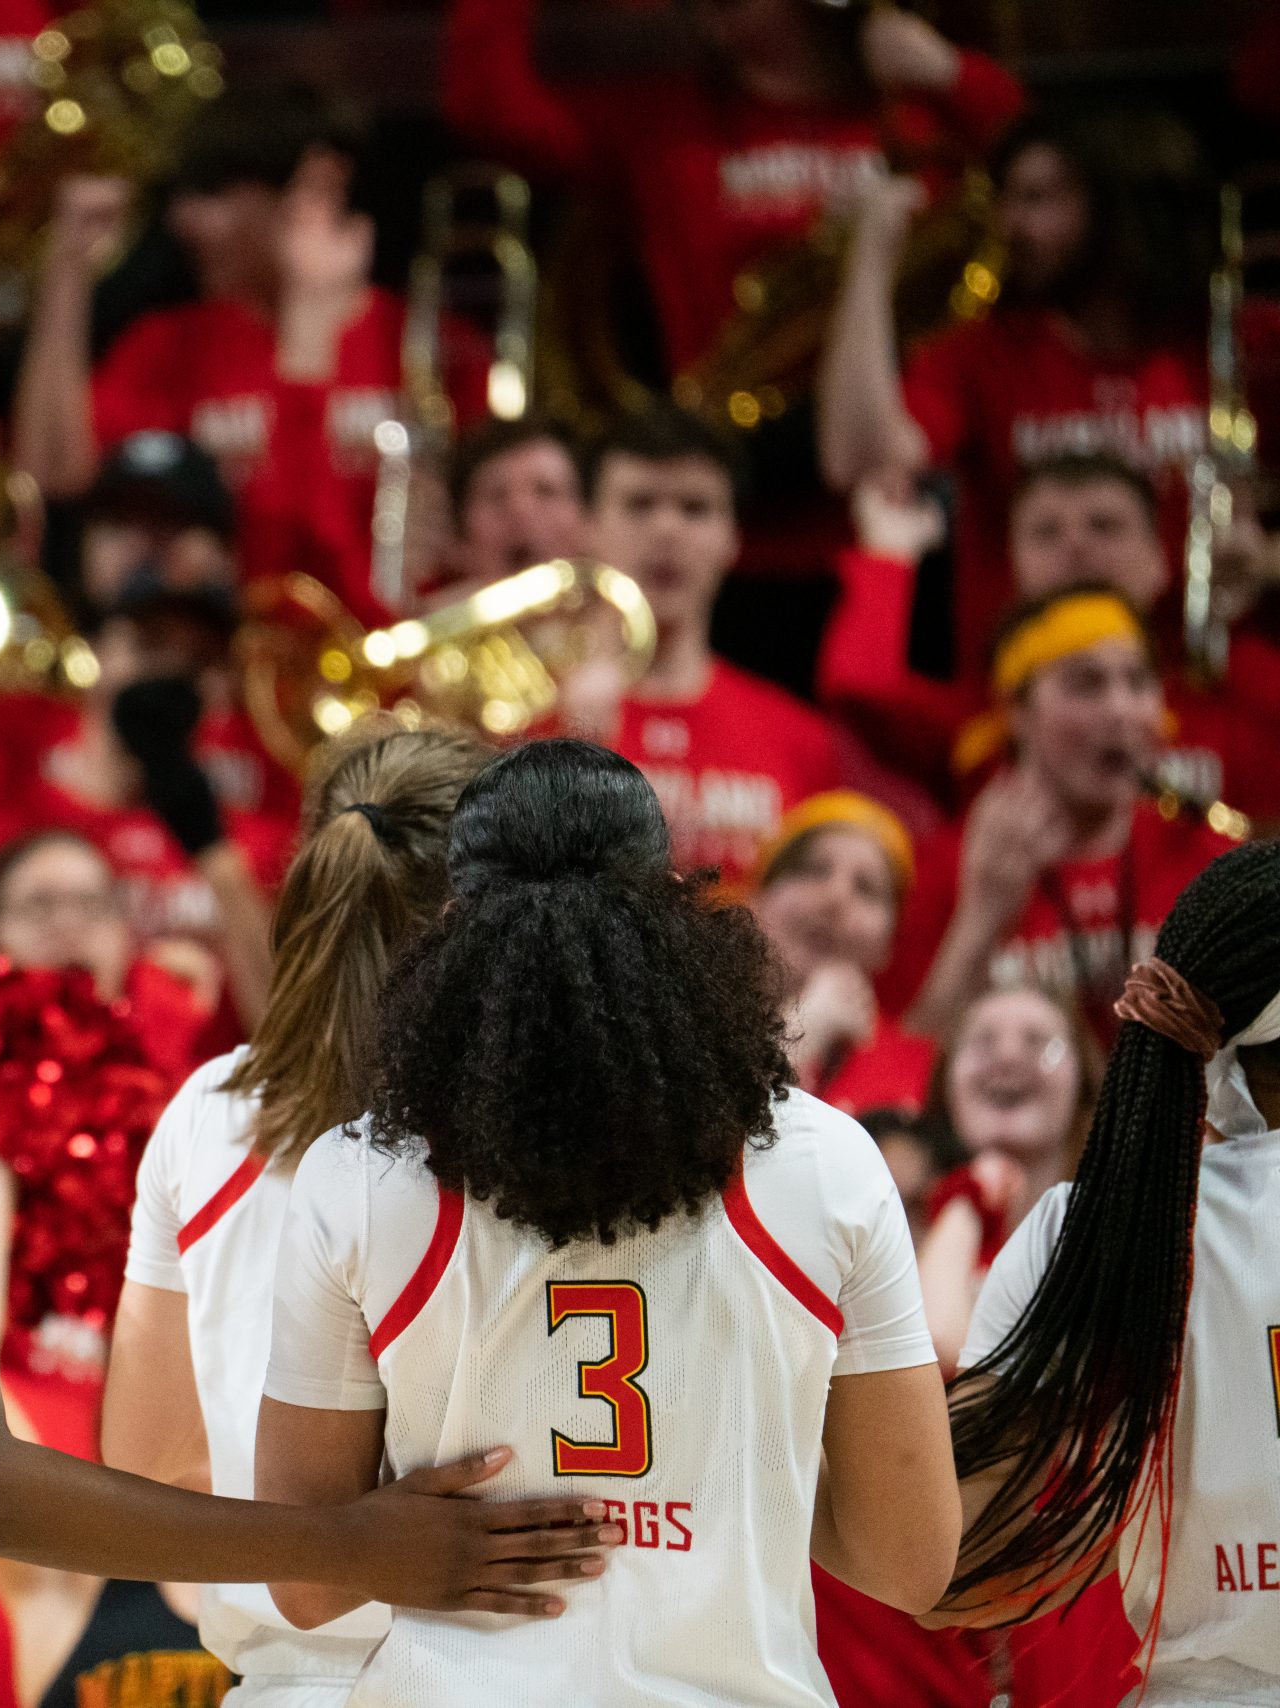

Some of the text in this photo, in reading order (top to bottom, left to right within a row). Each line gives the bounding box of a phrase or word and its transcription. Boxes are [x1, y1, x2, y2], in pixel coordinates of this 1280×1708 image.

[546, 1280, 653, 1478] 3
[585, 1499, 692, 1551] GGS
[1215, 1543, 1280, 1592] ALE
